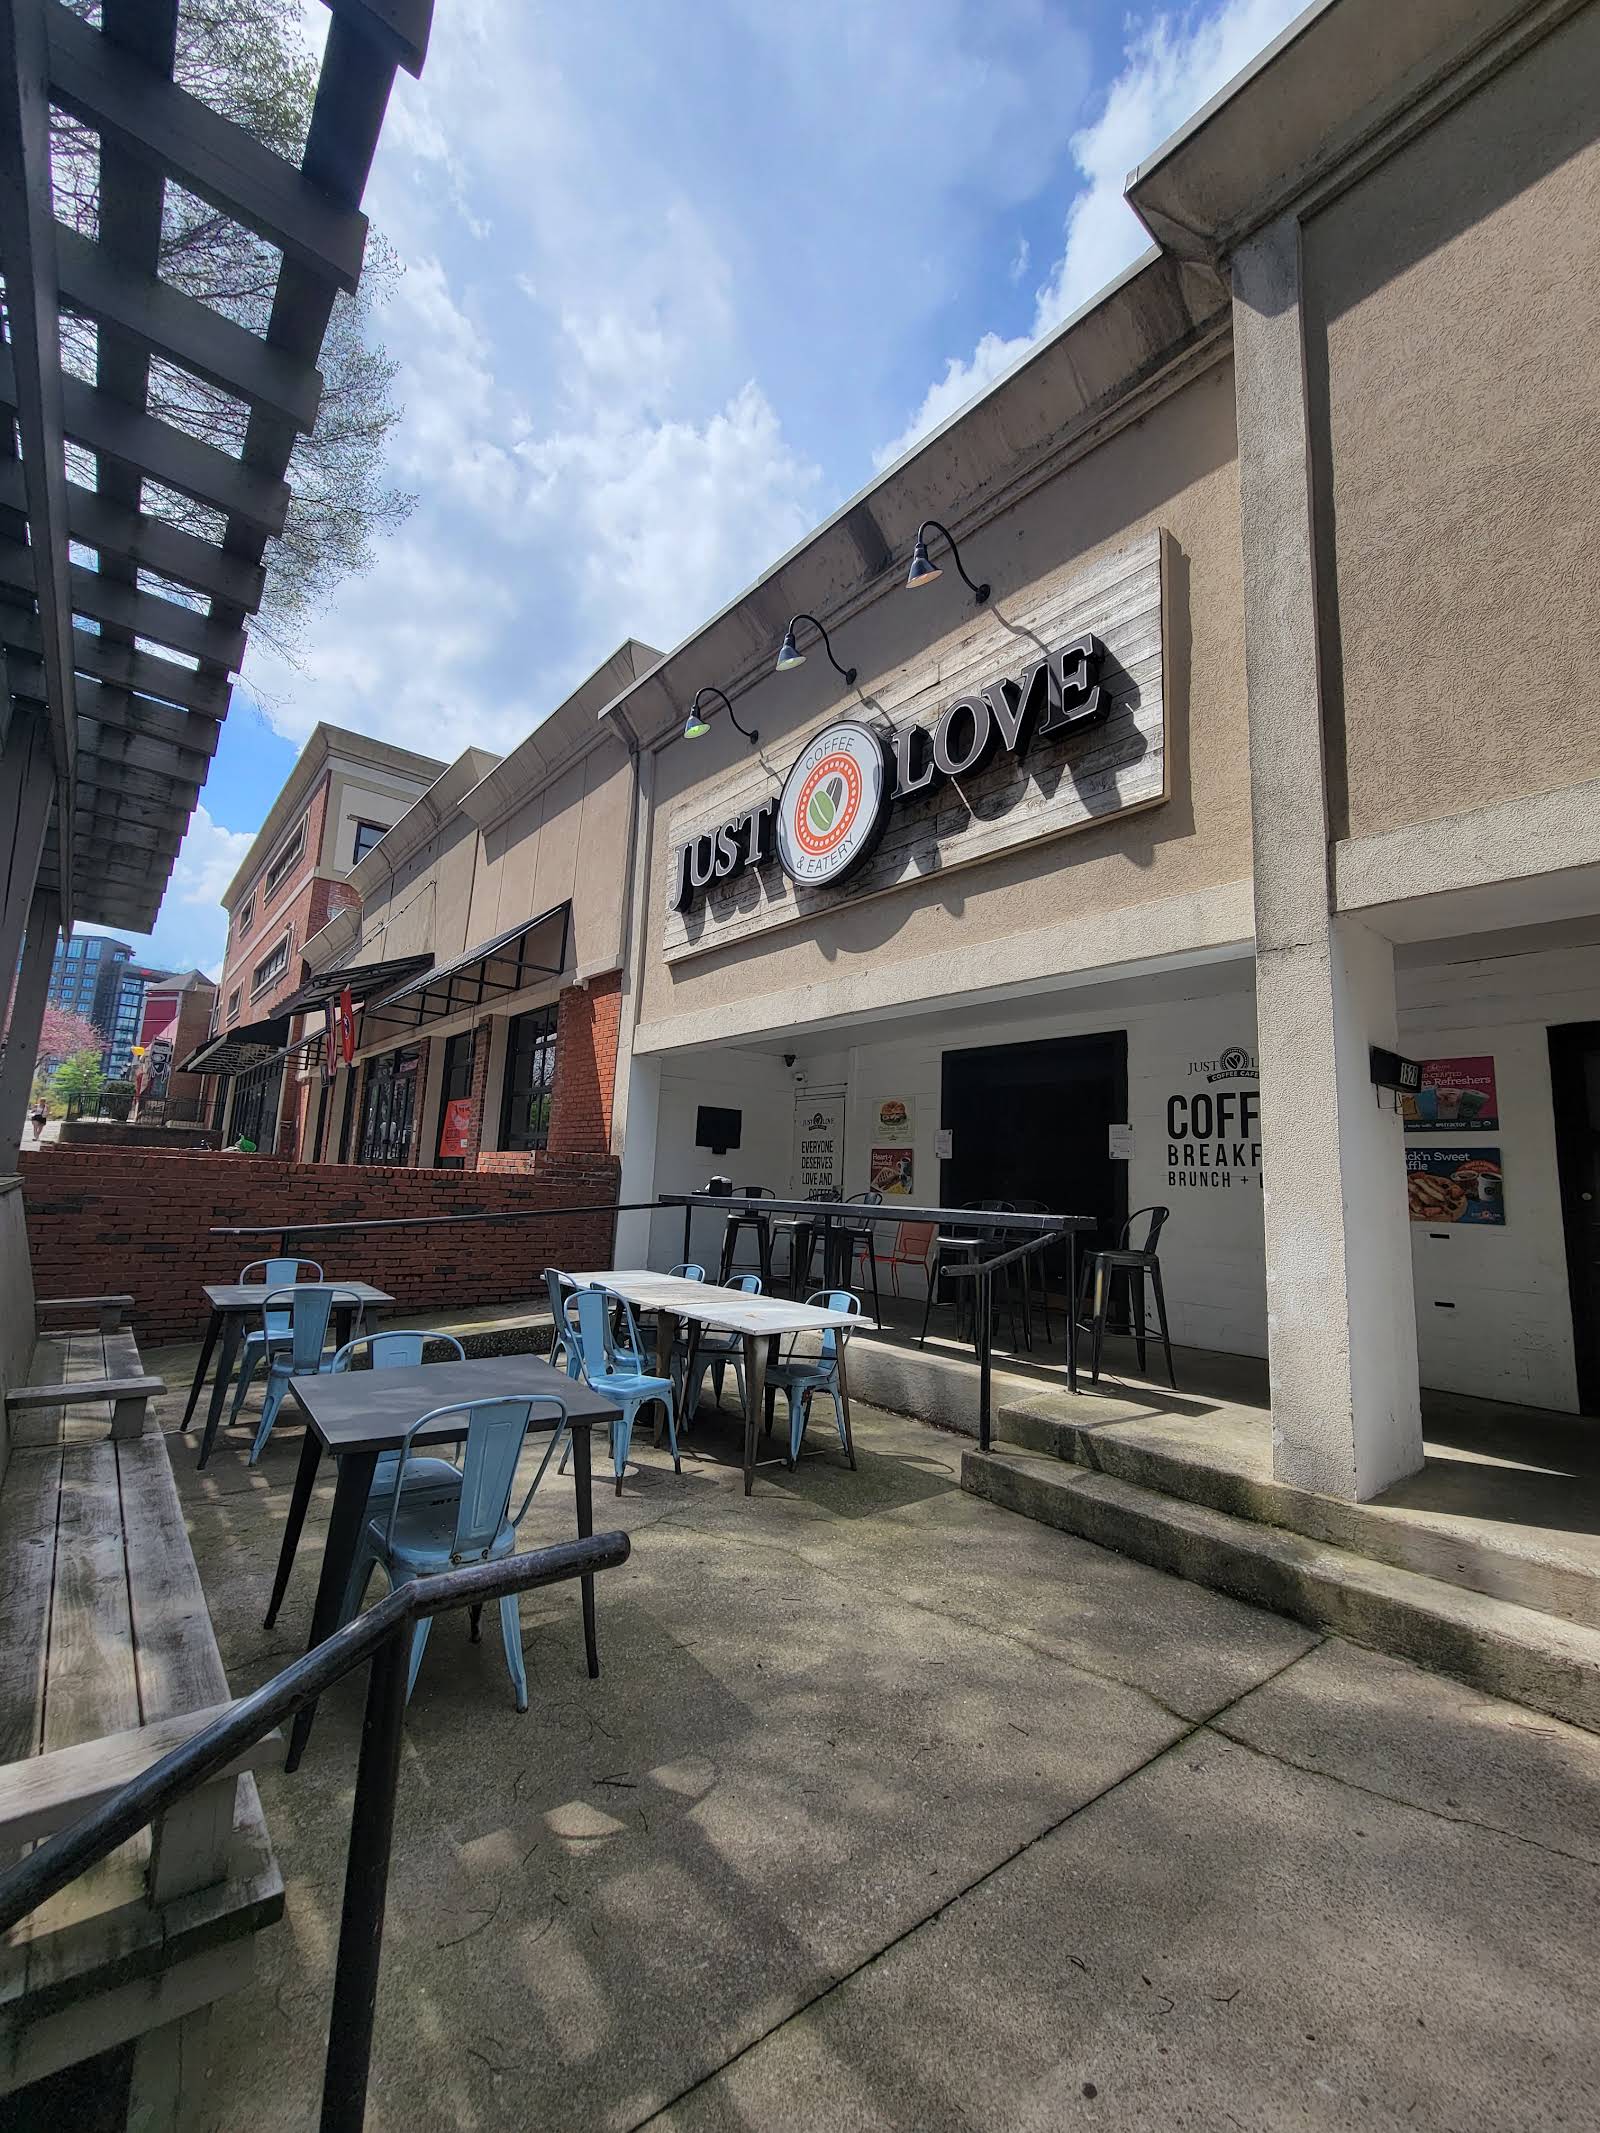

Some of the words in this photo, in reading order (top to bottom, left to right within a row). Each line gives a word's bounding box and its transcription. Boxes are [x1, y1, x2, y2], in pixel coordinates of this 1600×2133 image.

[806, 736, 855, 771] COFFEE
[669, 796, 775, 911] JUST
[890, 632, 1102, 801] LOVE
[796, 855, 805, 871] &
[806, 832, 854, 874] EATERY
[1187, 1060, 1219, 1076] JUST
[1211, 1070, 1239, 1081] COFFEE
[1435, 1075, 1491, 1086] Refreshers
[1167, 1091, 1260, 1140] COFF
[801, 1140, 833, 1154] EVERYONE
[801, 1156, 833, 1169] DESERVES
[1167, 1143, 1261, 1167] BREAKF
[1405, 1151, 1431, 1161] ick'n
[1434, 1151, 1471, 1161] Sweet
[1407, 1160, 1428, 1171] ffle
[802, 1173, 817, 1185] LOVE
[818, 1172, 832, 1186] AND
[1168, 1171, 1231, 1188] BRUNCH
